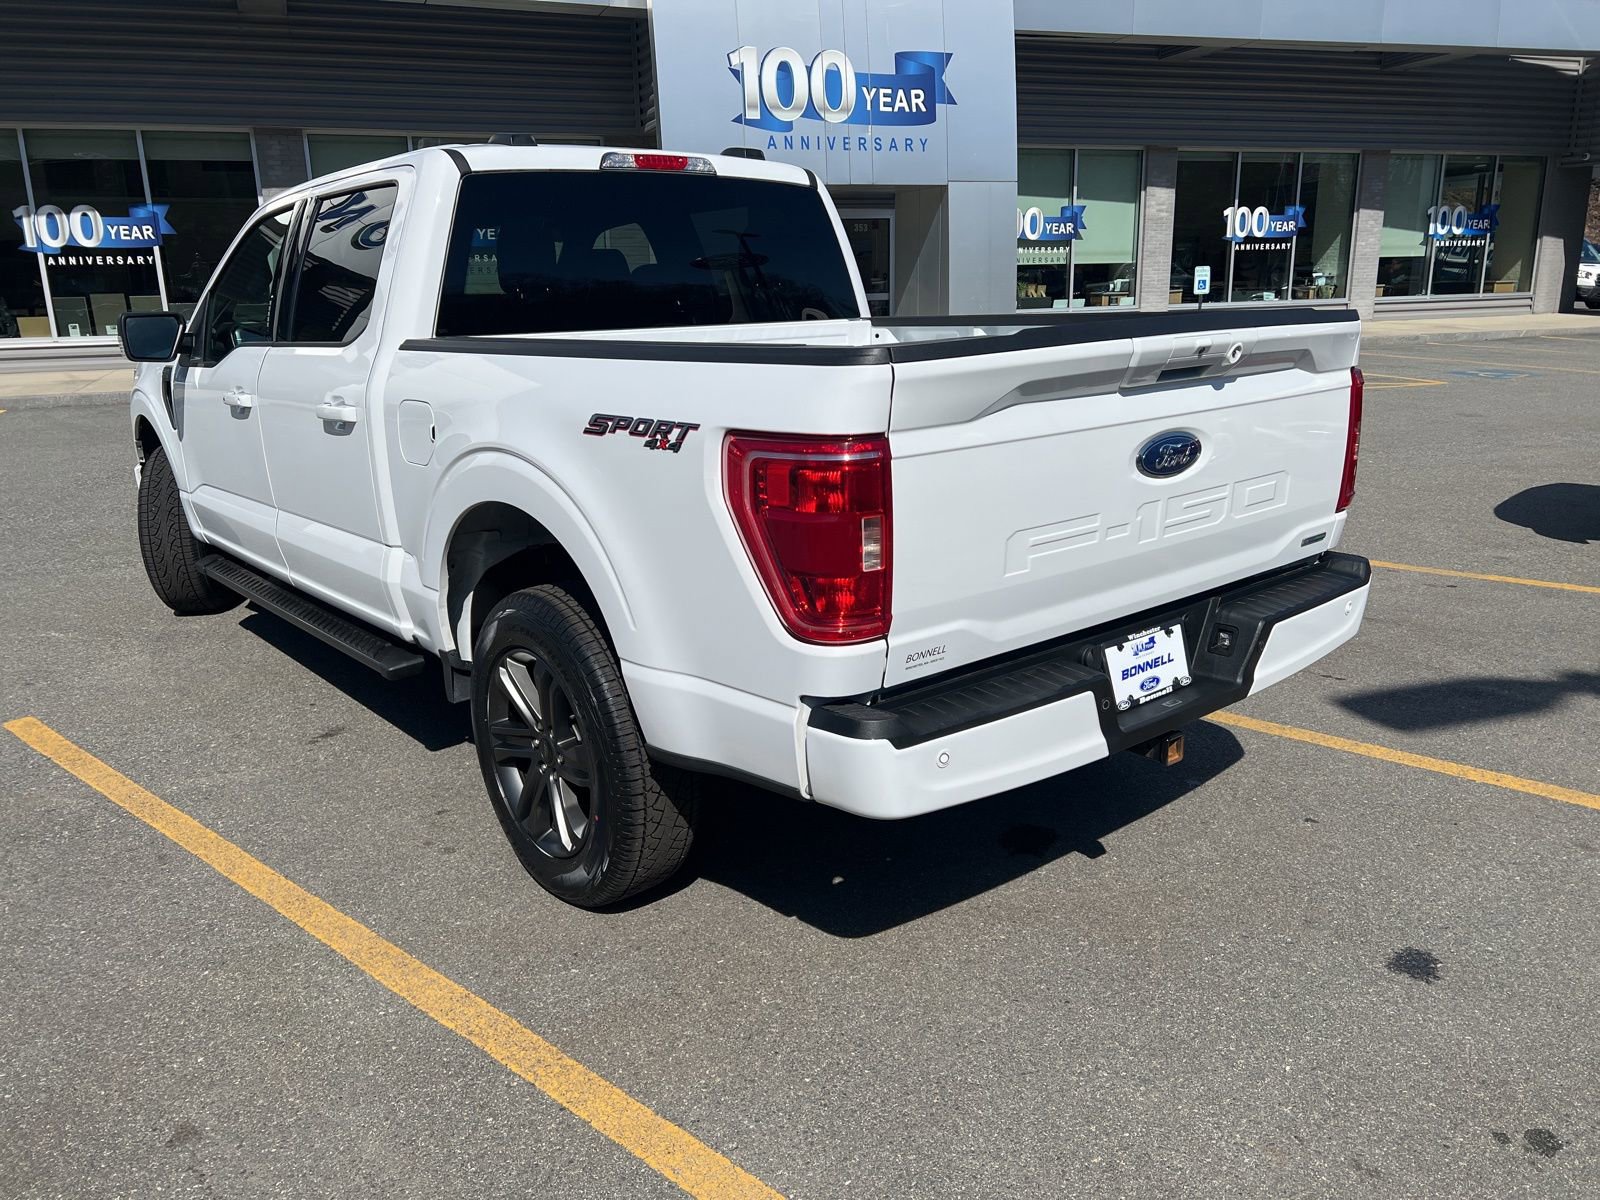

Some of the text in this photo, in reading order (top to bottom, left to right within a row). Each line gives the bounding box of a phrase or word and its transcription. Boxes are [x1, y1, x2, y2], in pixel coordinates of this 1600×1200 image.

[727, 45, 927, 123] 100 YEAR
[767, 135, 929, 152] ANNIVERSARY
[12, 204, 155, 248] 100 YEAR
[1045, 222, 1074, 235] YEAR
[1223, 206, 1297, 238] 100 YEAR
[1427, 205, 1491, 235] 100 YEAR
[476, 228, 500, 240] YE
[1234, 243, 1291, 251] ANNIVERSARY
[47, 256, 155, 266] ANNIVERSARY
[583, 413, 701, 443] SPORT
[643, 439, 681, 453] 4x4
[1155, 441, 1198, 469] Ford
[1003, 470, 1292, 578] F-150
[906, 645, 946, 663] BONNELL
[1121, 653, 1174, 680] BONNELL
